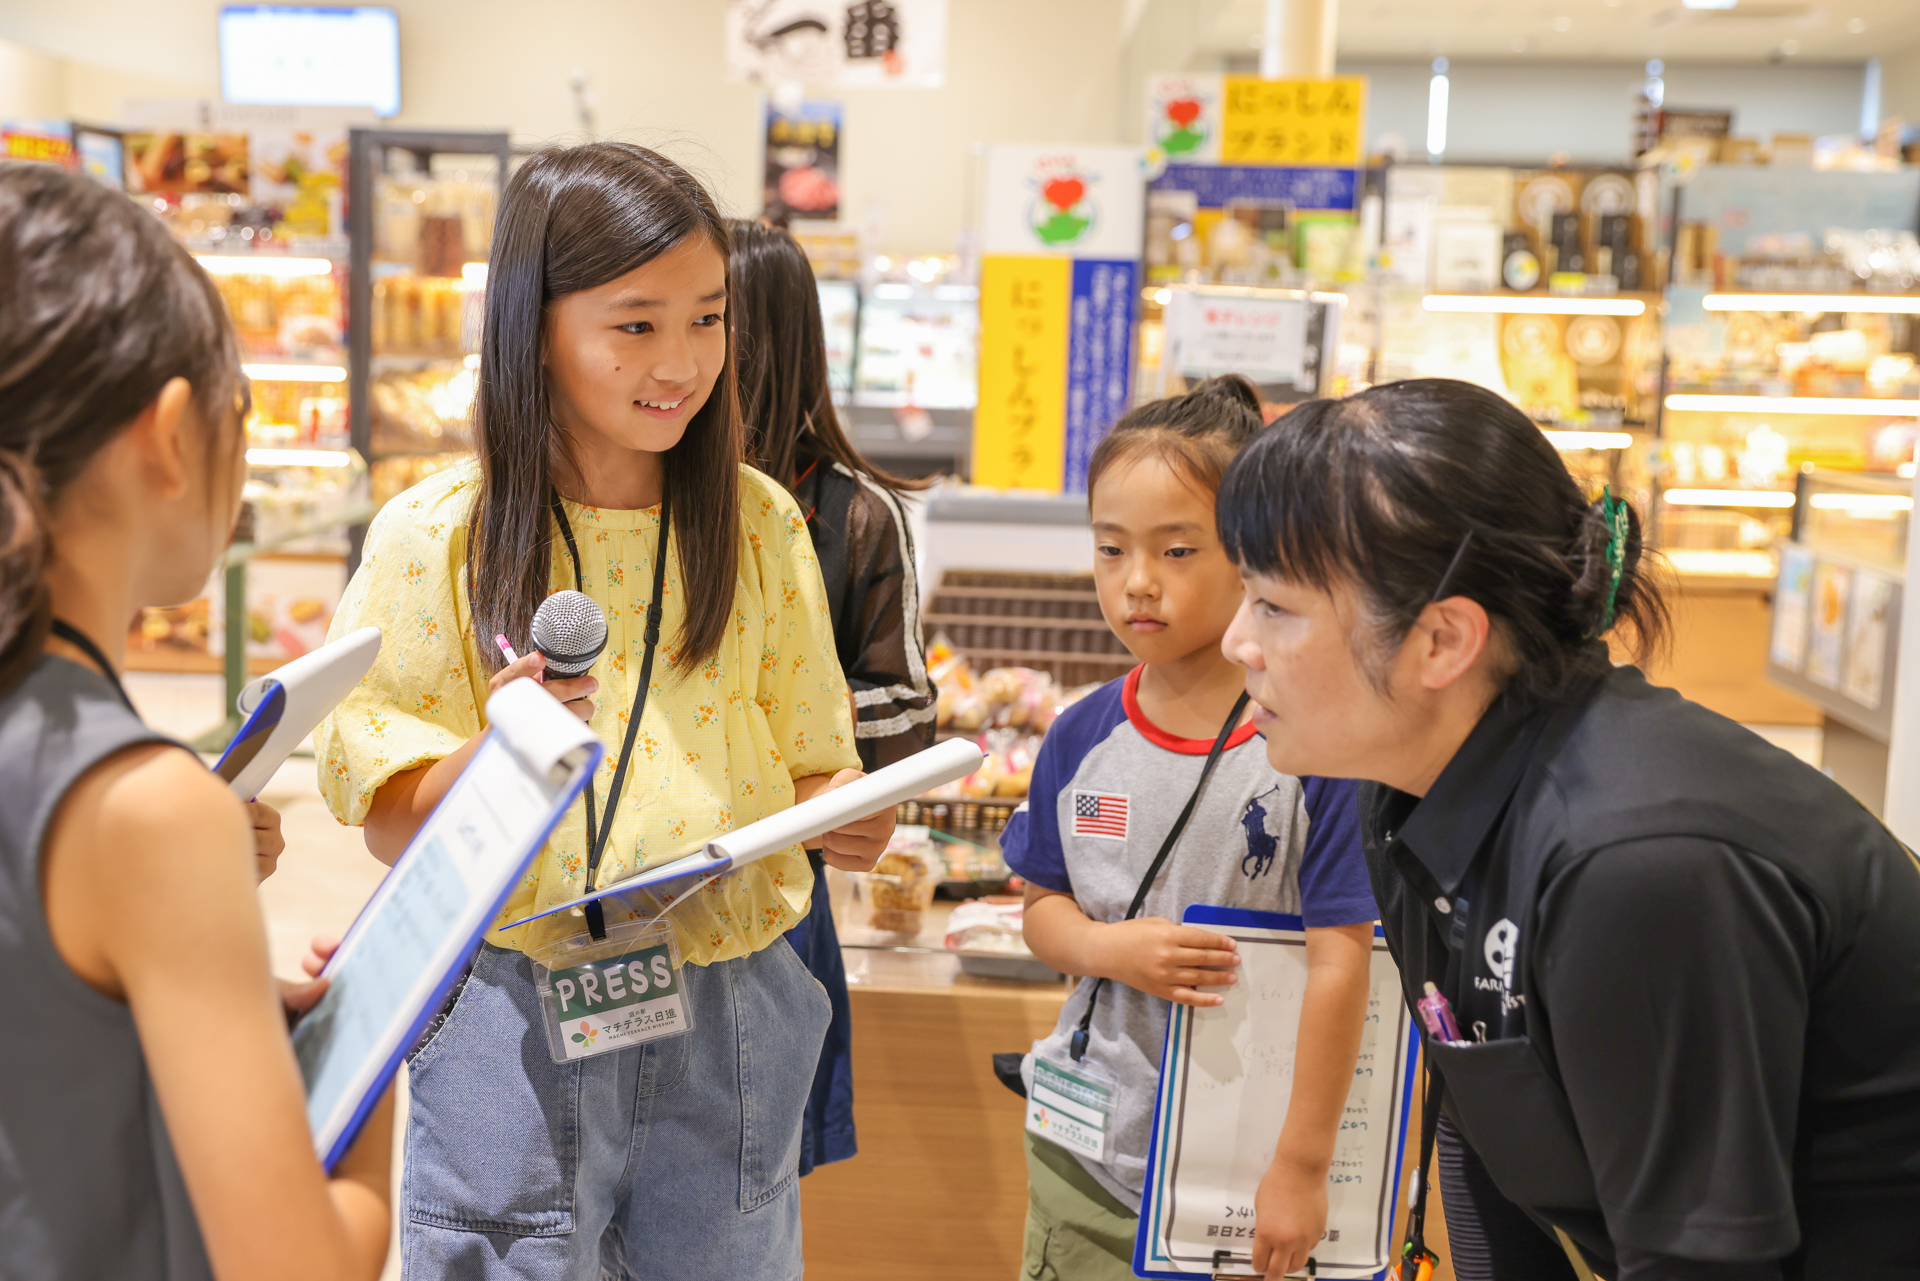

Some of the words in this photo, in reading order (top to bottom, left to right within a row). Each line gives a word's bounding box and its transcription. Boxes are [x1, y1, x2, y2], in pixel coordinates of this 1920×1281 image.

[1227, 83, 1357, 117] にっしん
[1225, 126, 1352, 161] ブランド
[1007, 277, 1046, 488] にっしんブラ
[555, 954, 672, 1013] PRESS
[602, 1008, 678, 1034] マチテラス日進
[608, 1031, 628, 1040] MACHI
[627, 1026, 652, 1036] TERRACE
[652, 1020, 675, 1030] NISSHIN
